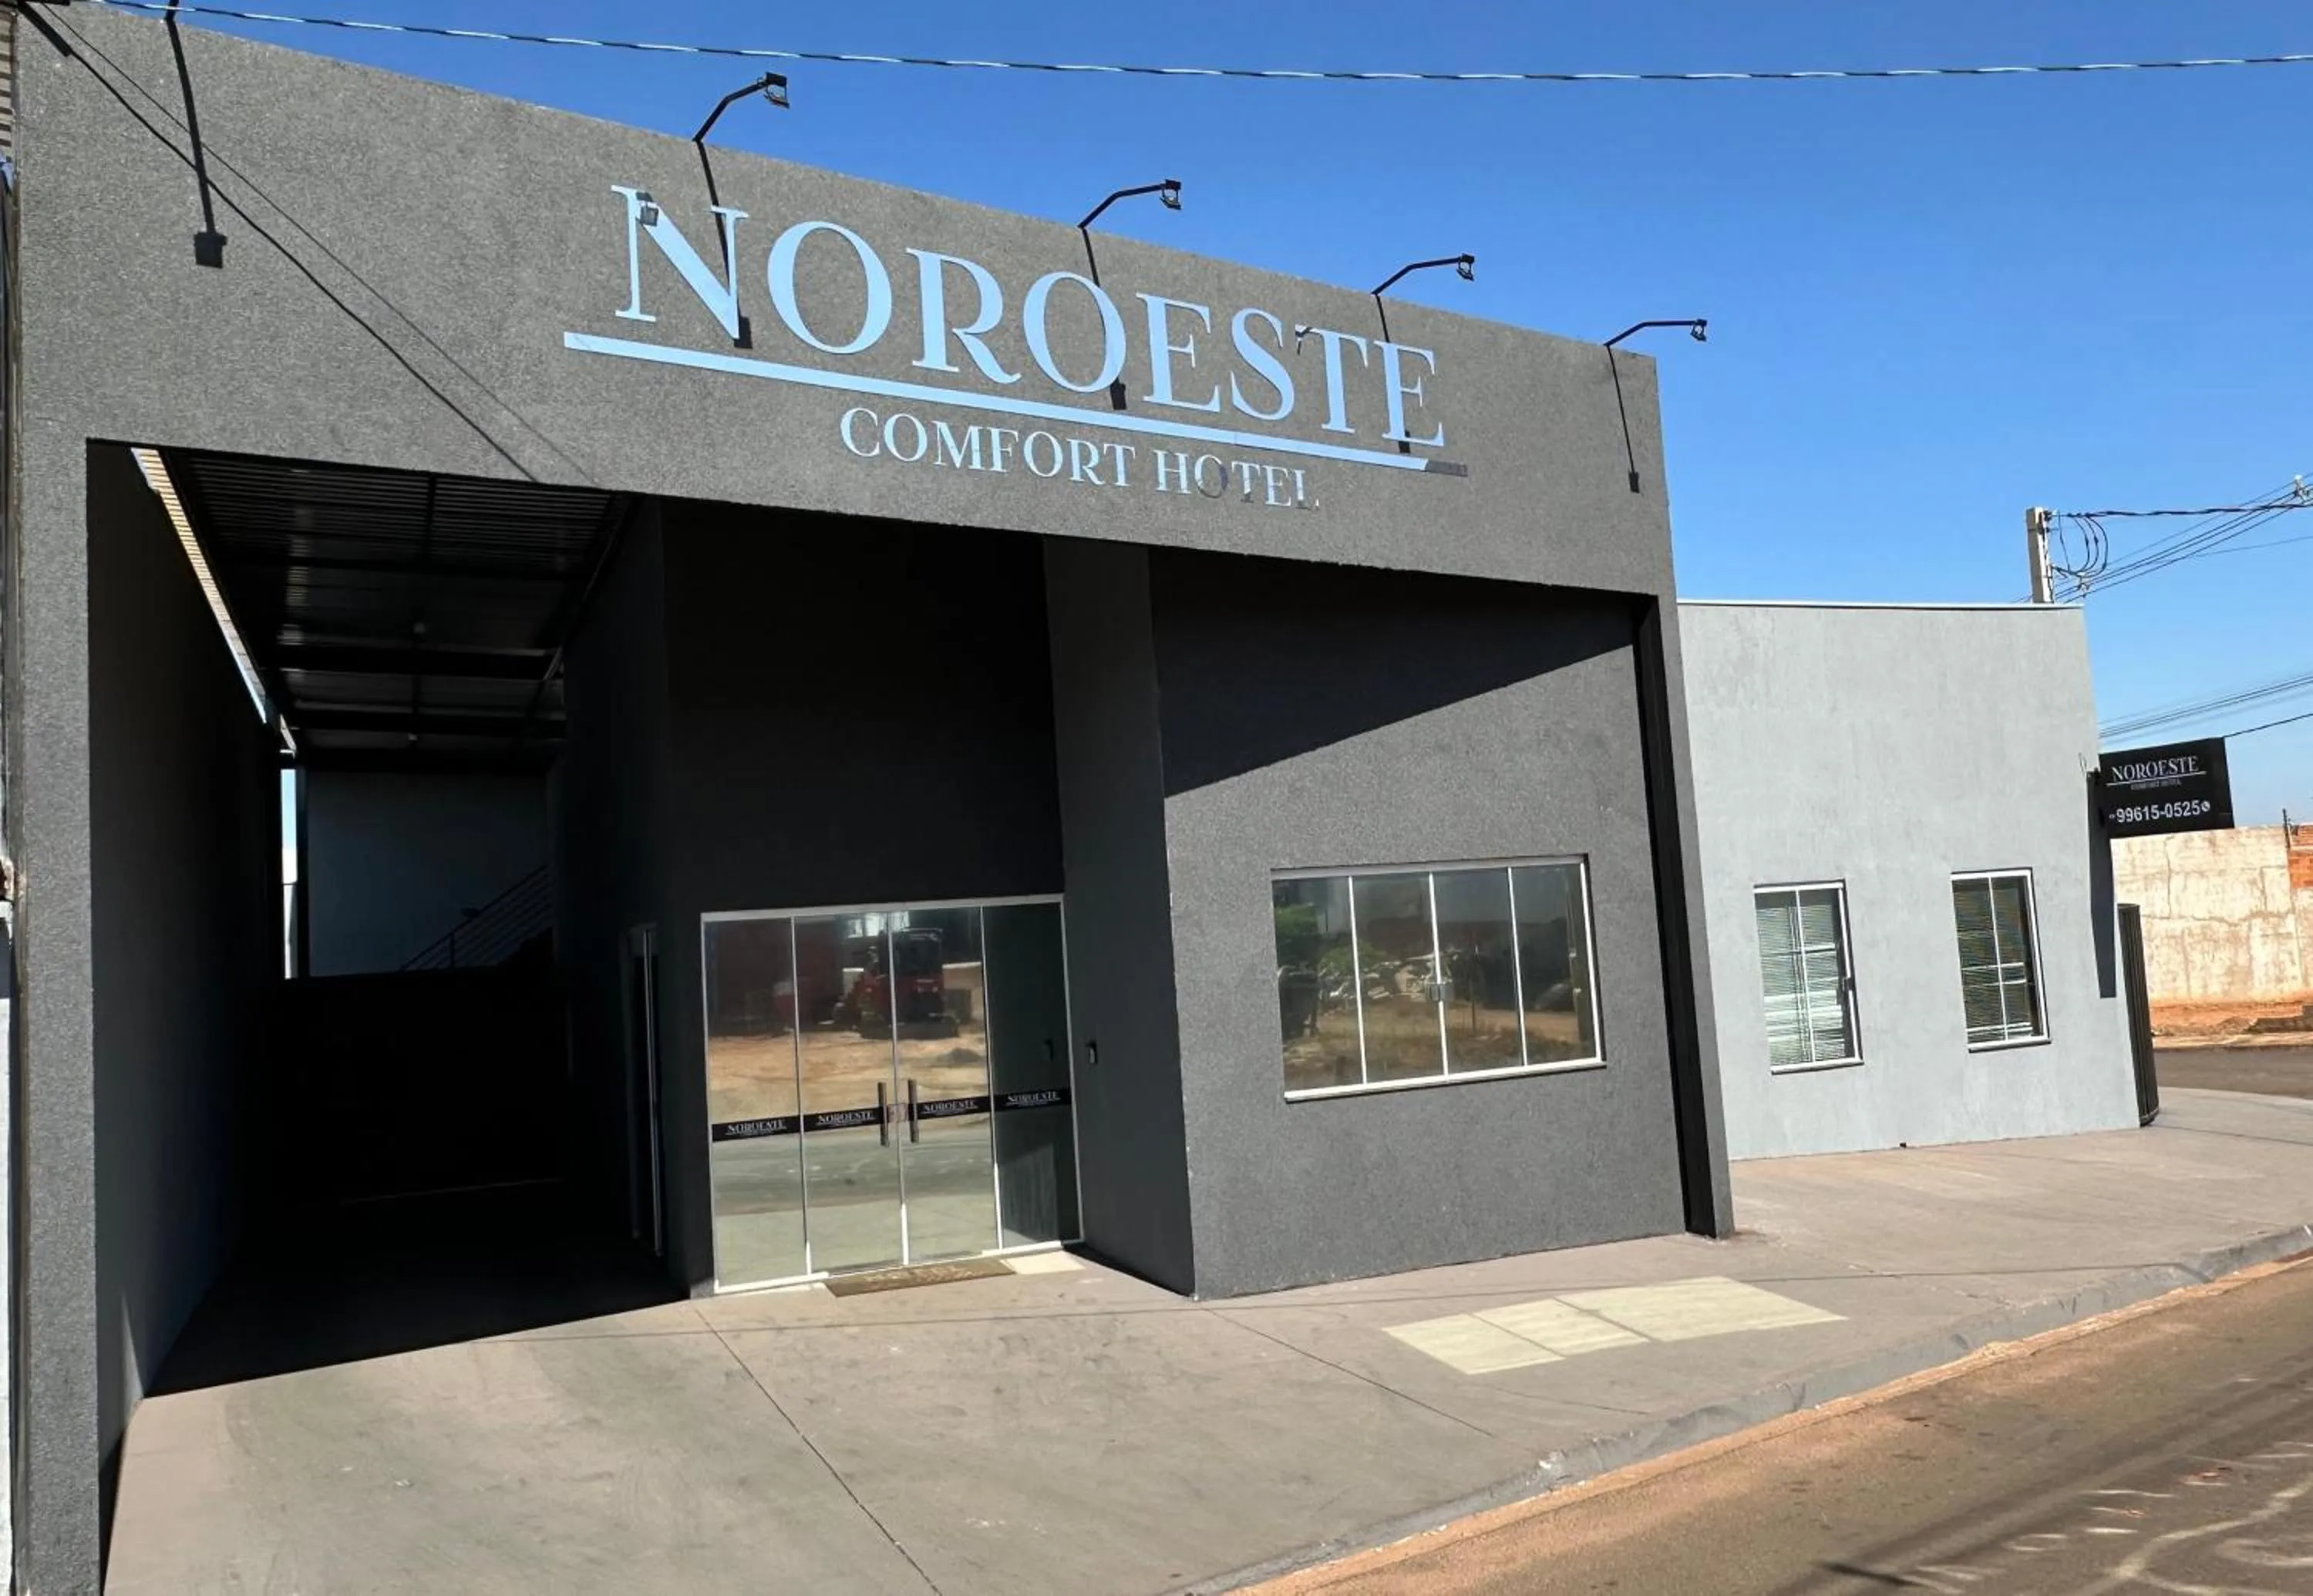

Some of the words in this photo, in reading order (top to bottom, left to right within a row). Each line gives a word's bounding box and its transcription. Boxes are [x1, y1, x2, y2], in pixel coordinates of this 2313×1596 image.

[611, 184, 1445, 448] NOROESTE
[840, 408, 1136, 487] COMFORT
[1153, 449, 1320, 510] HOTEL
[2111, 756, 2199, 782] NOROESTE
[2116, 800, 2200, 823] 99615-0525
